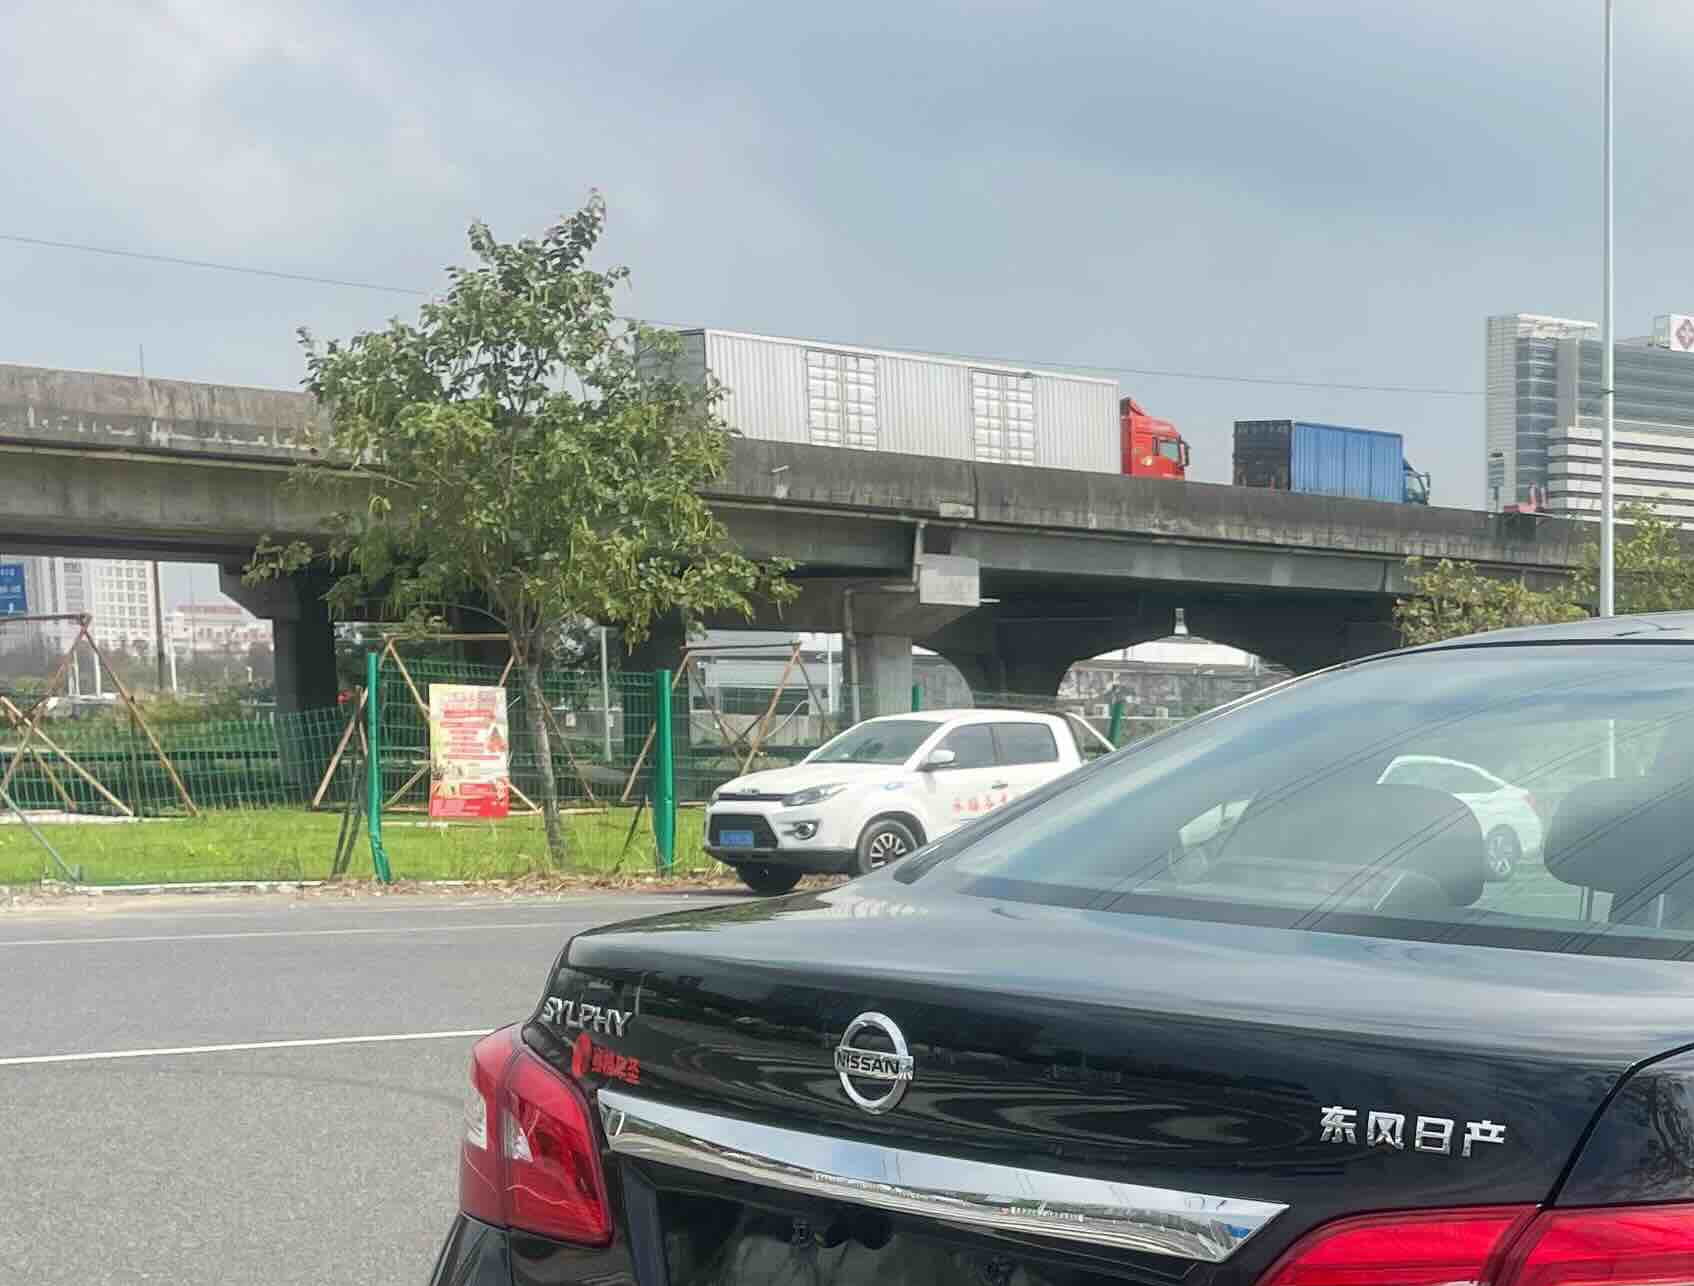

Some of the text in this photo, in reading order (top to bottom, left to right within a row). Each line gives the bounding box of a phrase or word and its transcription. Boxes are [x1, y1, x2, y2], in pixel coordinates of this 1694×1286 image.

[543, 996, 632, 1037] SYLPHY
[837, 1051, 899, 1075] NISSAN
[1320, 1105, 1506, 1157] 东风日产
